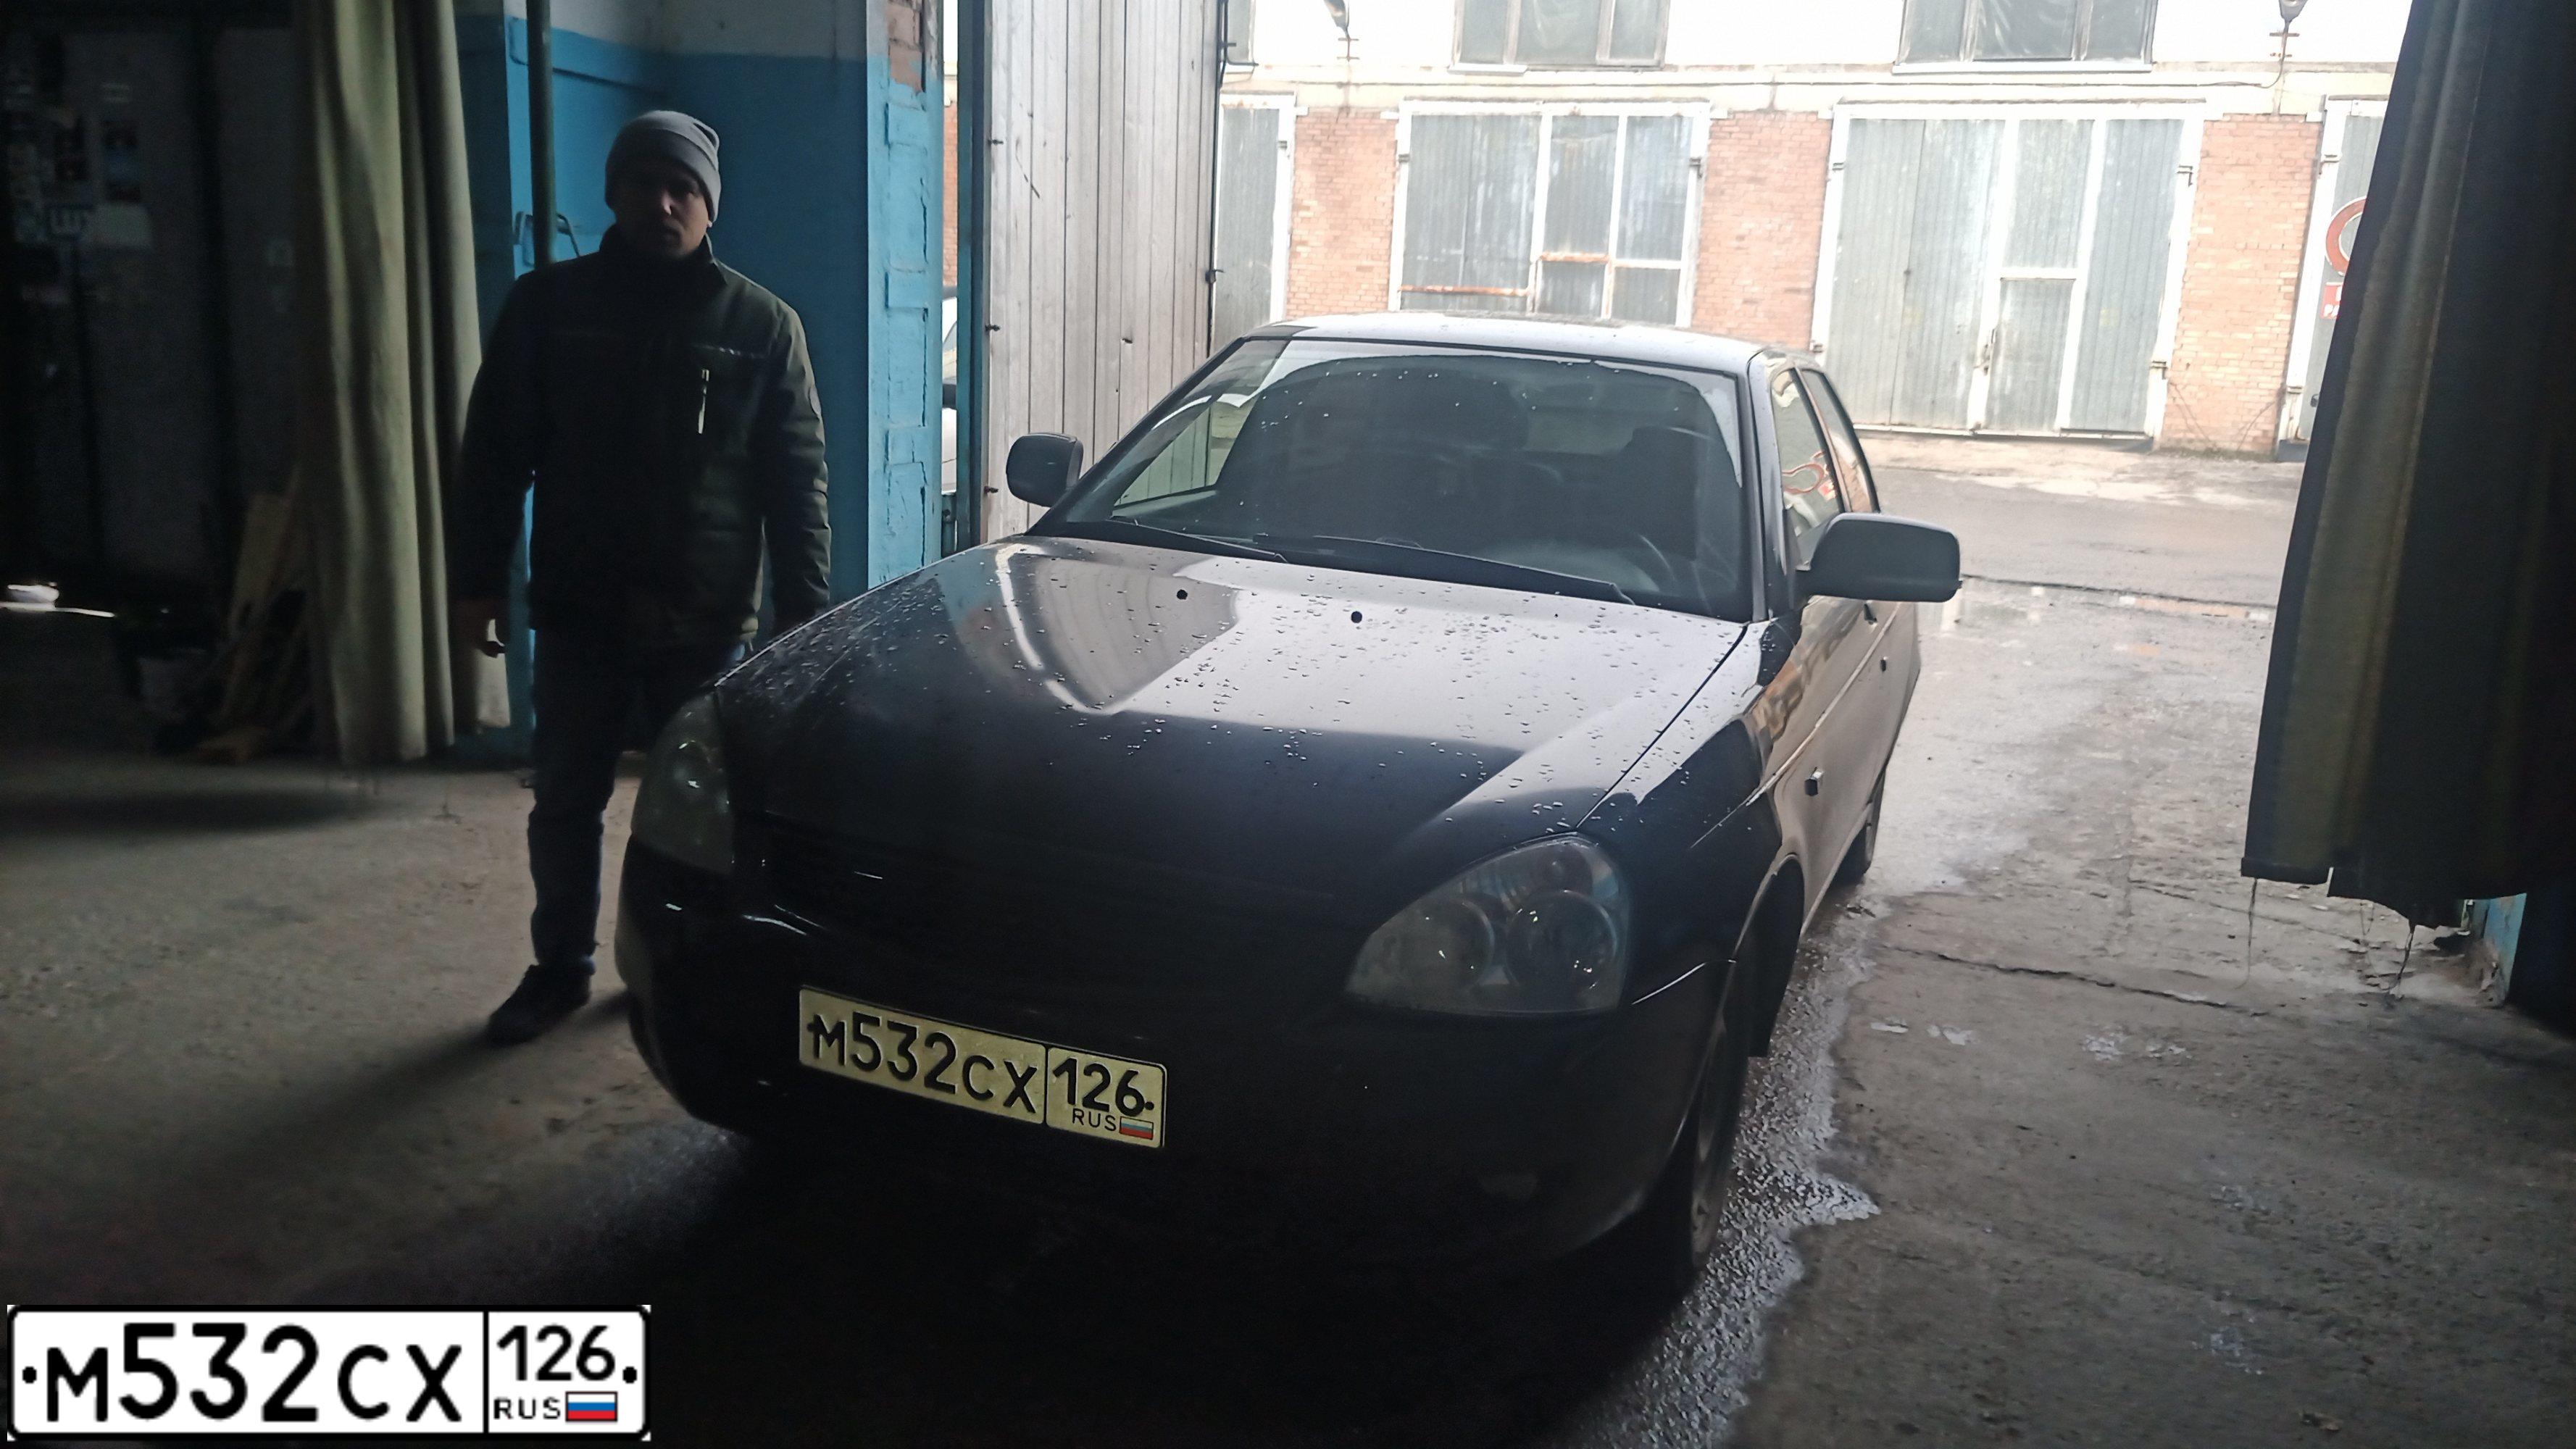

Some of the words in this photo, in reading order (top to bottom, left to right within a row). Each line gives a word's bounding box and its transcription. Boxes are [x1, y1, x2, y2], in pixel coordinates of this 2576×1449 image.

[812, 1009, 1038, 1114] М532СХ
[1052, 1057, 1145, 1117] 126
[1072, 1108, 1117, 1132] RUS
